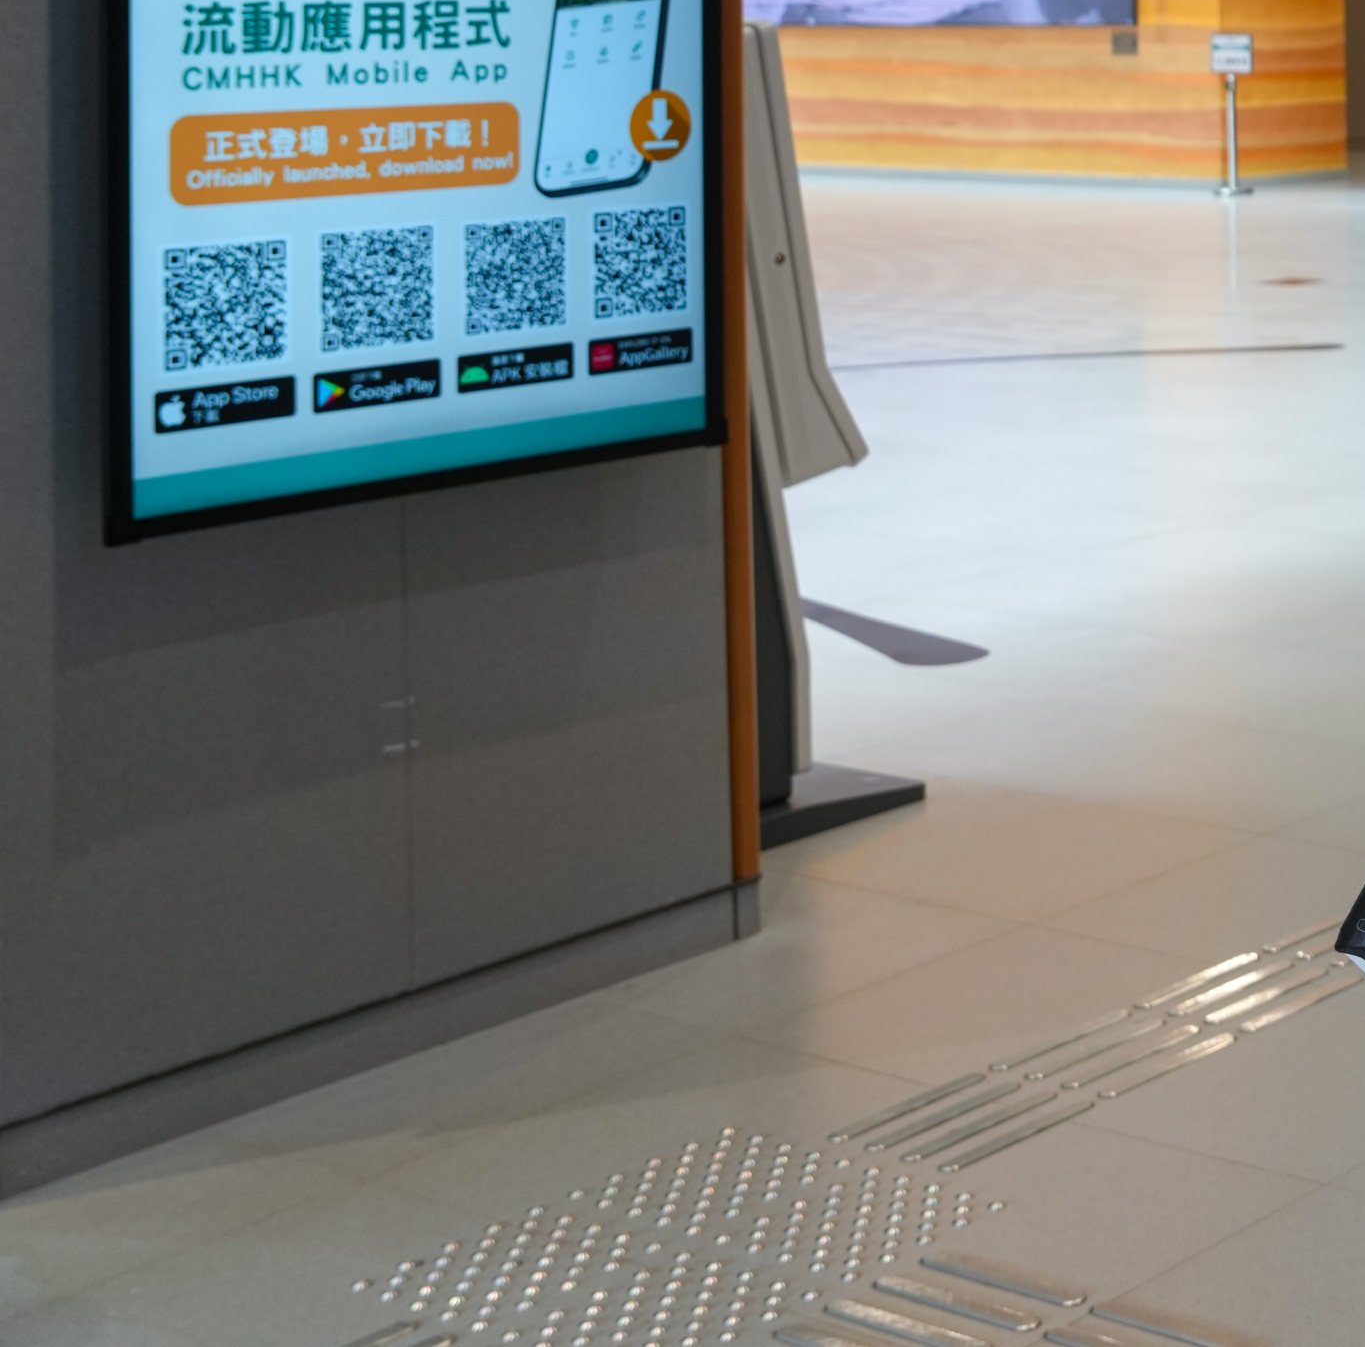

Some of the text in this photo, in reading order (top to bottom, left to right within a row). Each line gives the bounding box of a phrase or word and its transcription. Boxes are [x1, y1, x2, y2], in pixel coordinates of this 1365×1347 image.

[182, 0, 511, 55] 流動應用程式
[182, 59, 508, 90] CMHHK Mobile App
[186, 152, 514, 190] Officially launched, download now!
[618, 345, 689, 367] AppGallery
[491, 365, 522, 384] APK
[192, 384, 279, 411] App Store
[348, 380, 404, 404] Google
[405, 376, 436, 396] Play
